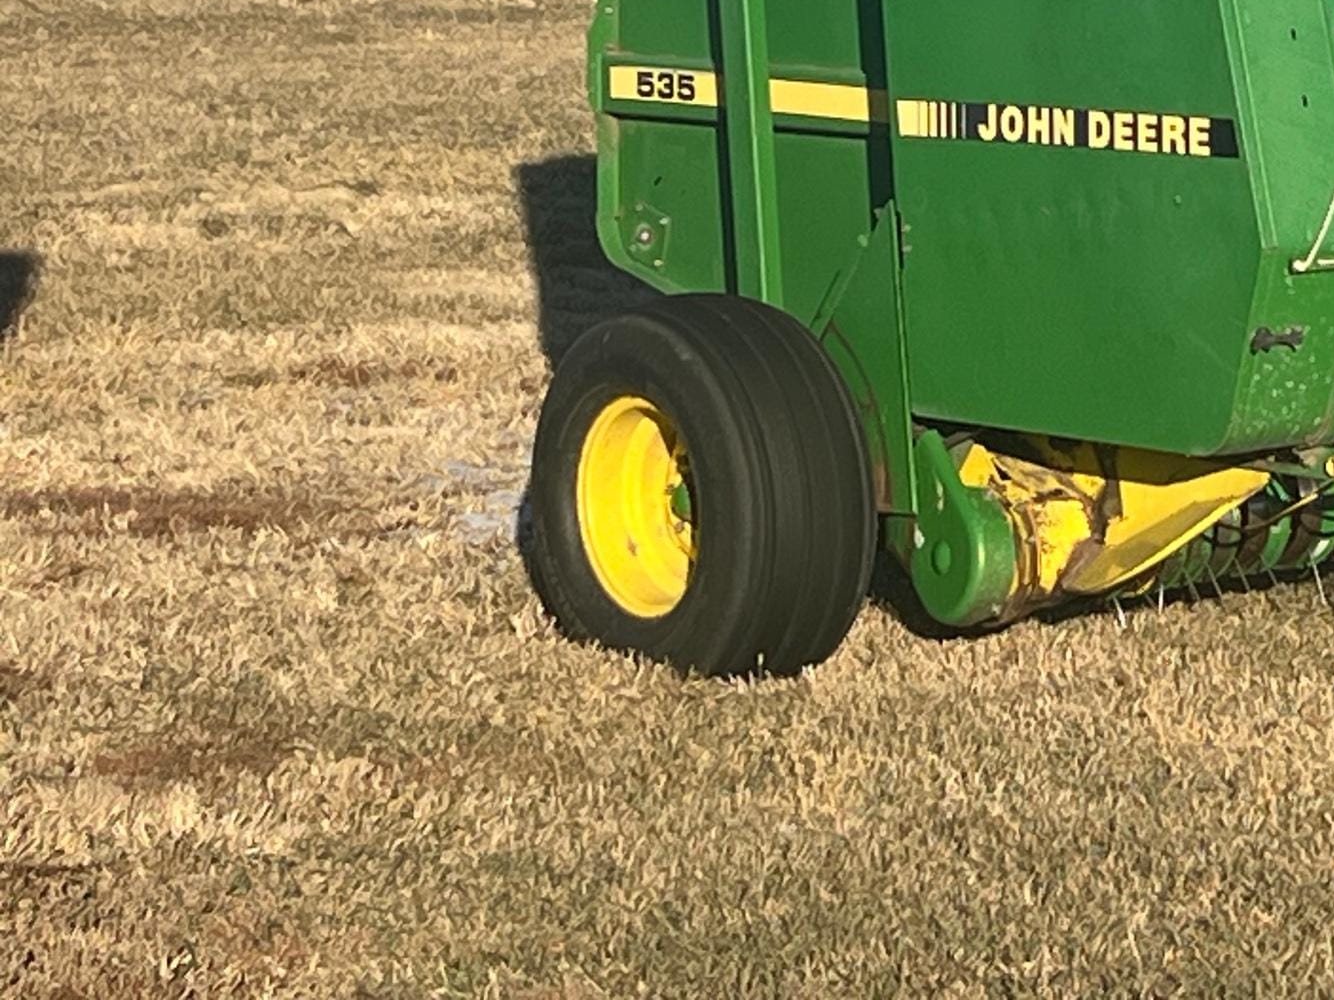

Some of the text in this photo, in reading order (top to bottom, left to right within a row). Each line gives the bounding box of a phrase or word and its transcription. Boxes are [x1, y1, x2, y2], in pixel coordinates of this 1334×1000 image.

[637, 72, 695, 101] 535
[977, 103, 1211, 157] JOHN DEERE
